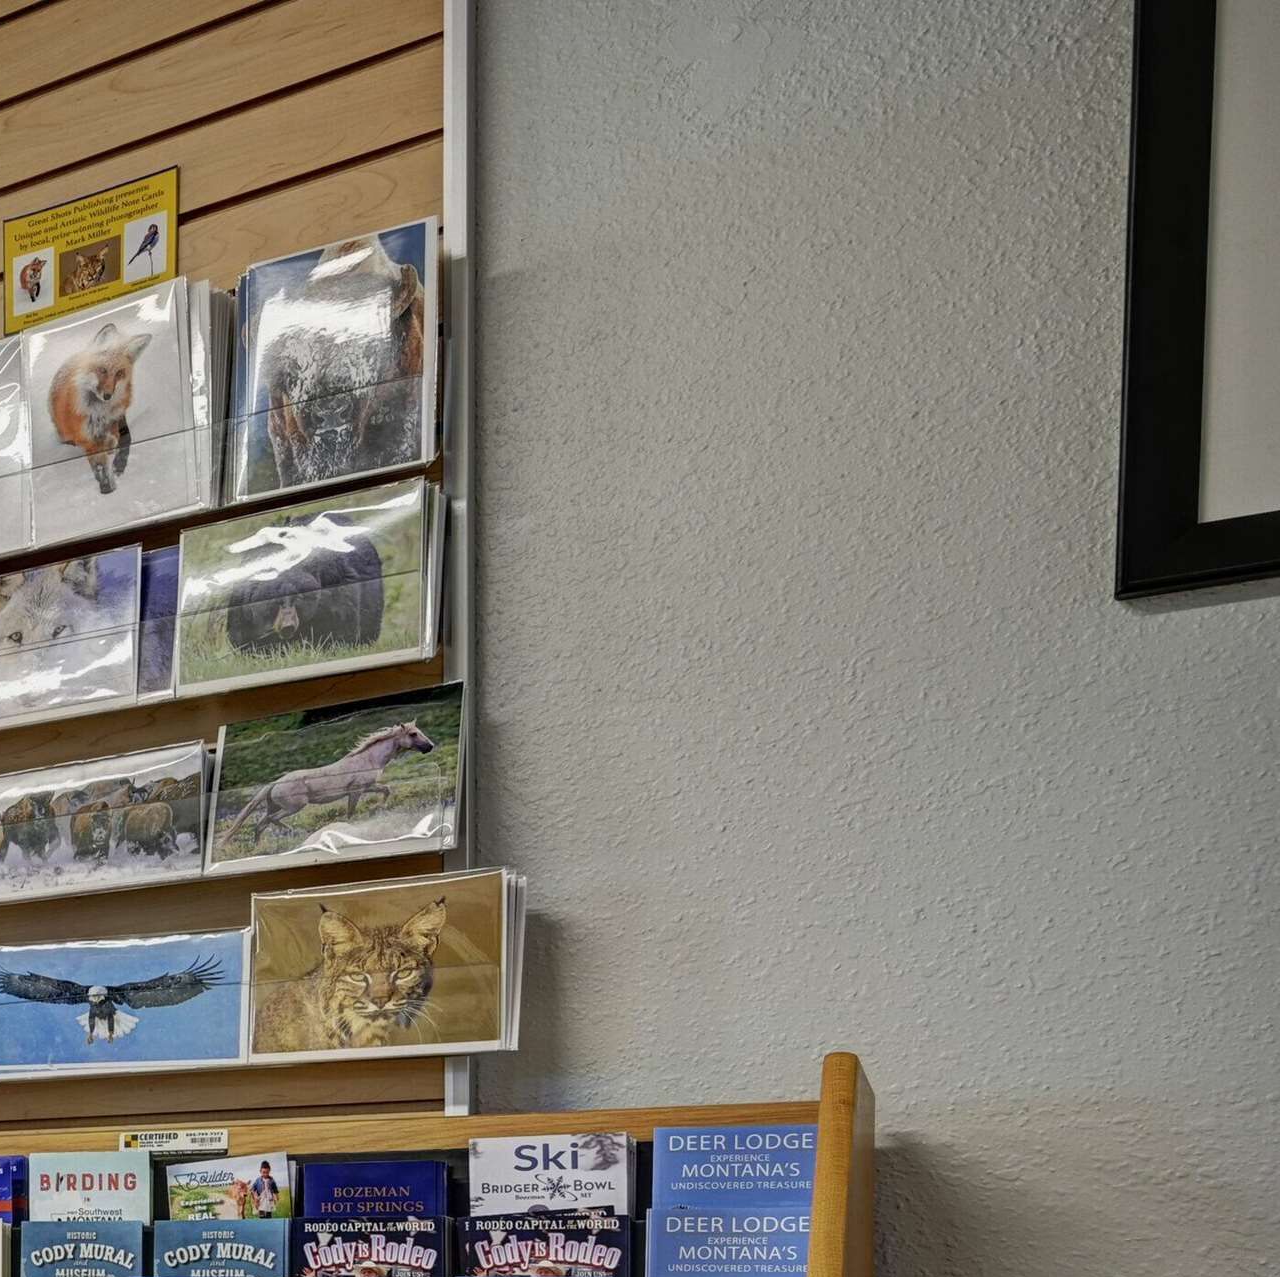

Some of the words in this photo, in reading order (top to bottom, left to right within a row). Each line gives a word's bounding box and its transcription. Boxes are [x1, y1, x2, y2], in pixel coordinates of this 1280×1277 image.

[14, 229, 42, 242] Unique
[44, 224, 58, 234] and
[60, 215, 88, 228] Artistic
[90, 204, 120, 218] Wildlife
[121, 198, 139, 210] Note
[141, 190, 164, 202] Cards
[28, 218, 48, 227] Great
[50, 211, 71, 223] Shots
[74, 196, 113, 213] Publishing
[19, 242, 28, 251] by
[52, 222, 103, 243] prize-winning
[105, 203, 159, 226] photographer
[65, 236, 85, 248] Mark
[87, 227, 111, 240] Miller
[139, 1132, 179, 1141] CERTIFIED
[668, 1134, 726, 1151] DEER
[734, 1132, 814, 1151] LODGE
[513, 1142, 580, 1173] Ski
[39, 1172, 138, 1193] BIRDING
[334, 1185, 411, 1199] BOZEMAN
[481, 1182, 539, 1194] BRIDGER
[573, 1179, 616, 1192] BOWL
[321, 1202, 353, 1214] HOT
[356, 1200, 425, 1213] SPRINGS
